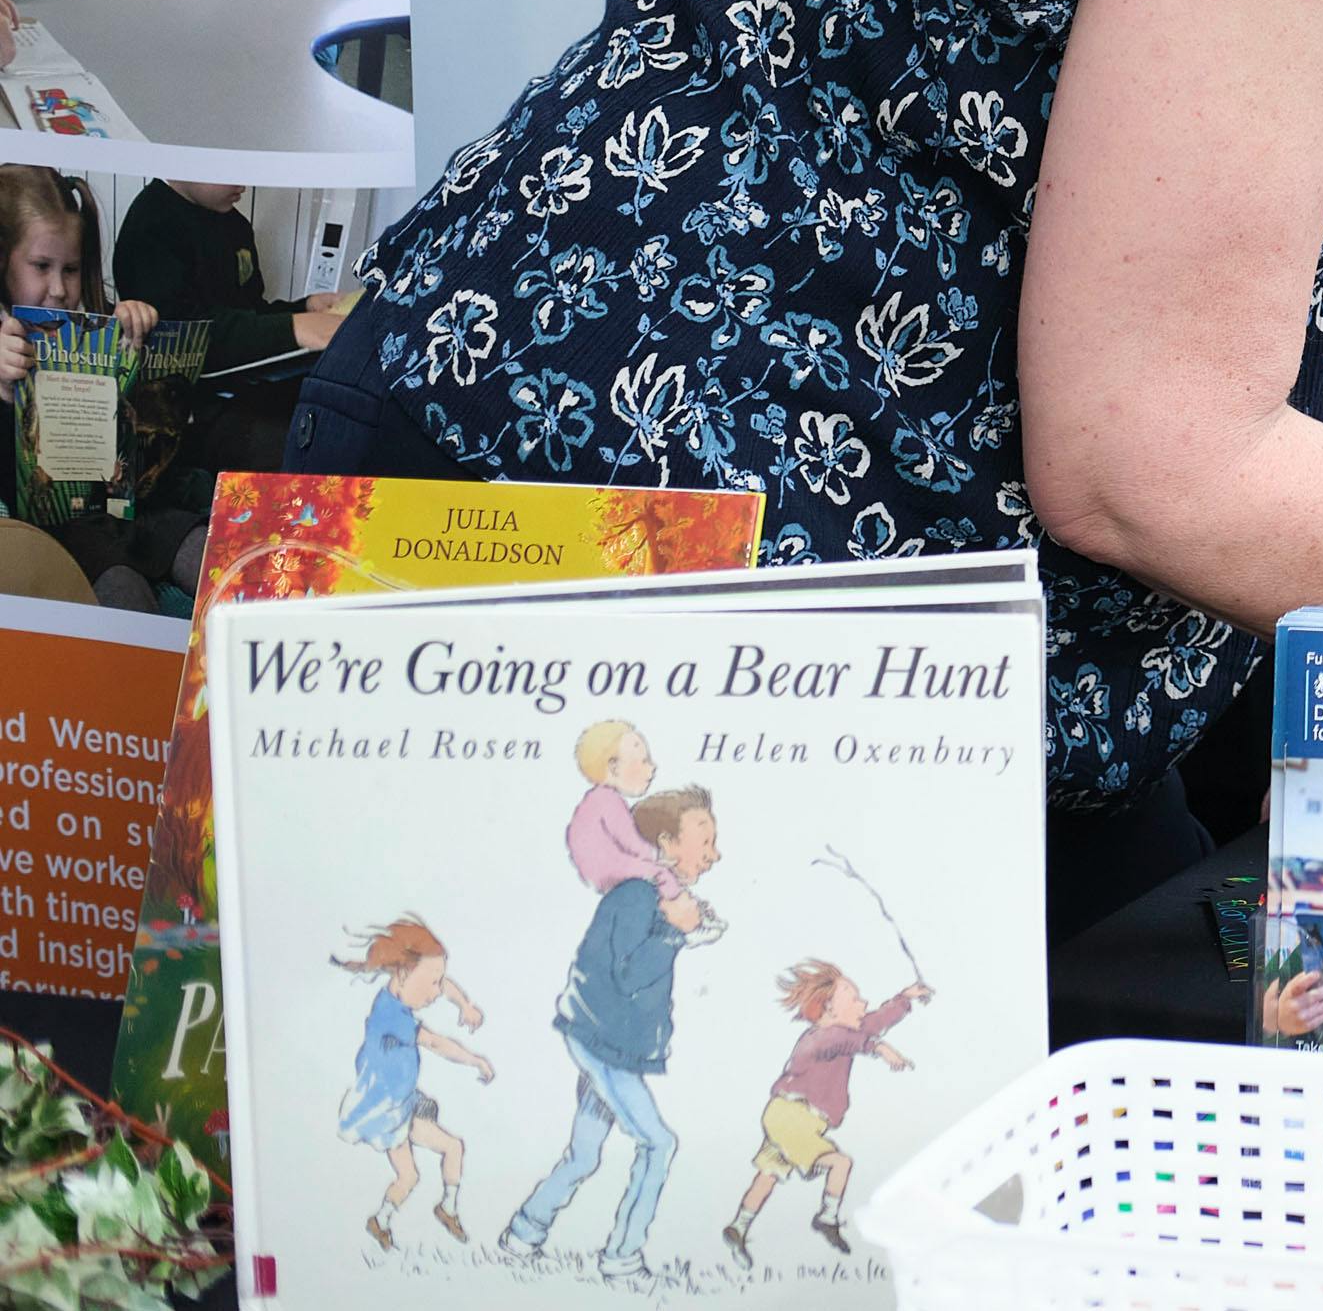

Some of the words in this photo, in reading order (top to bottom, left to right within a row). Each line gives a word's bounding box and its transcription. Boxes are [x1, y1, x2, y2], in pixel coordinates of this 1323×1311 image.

[35, 339, 117, 369] Dinosaur
[441, 507, 519, 533] JULIA
[392, 537, 564, 566] DONALDSON
[243, 638, 382, 695] We're
[405, 639, 571, 714] Going
[587, 662, 650, 697] on
[665, 662, 699, 698] a
[715, 644, 851, 698] Bear
[865, 645, 1012, 699] Hunt
[249, 728, 411, 760] Michael
[430, 729, 544, 761] Rosen
[695, 733, 809, 764] Helen
[833, 734, 1016, 777] Oxenbury
[0, 799, 30, 831] d
[57, 812, 102, 840] on
[46, 853, 145, 890] worke
[46, 890, 137, 933] times
[38, 931, 133, 978] insigh
